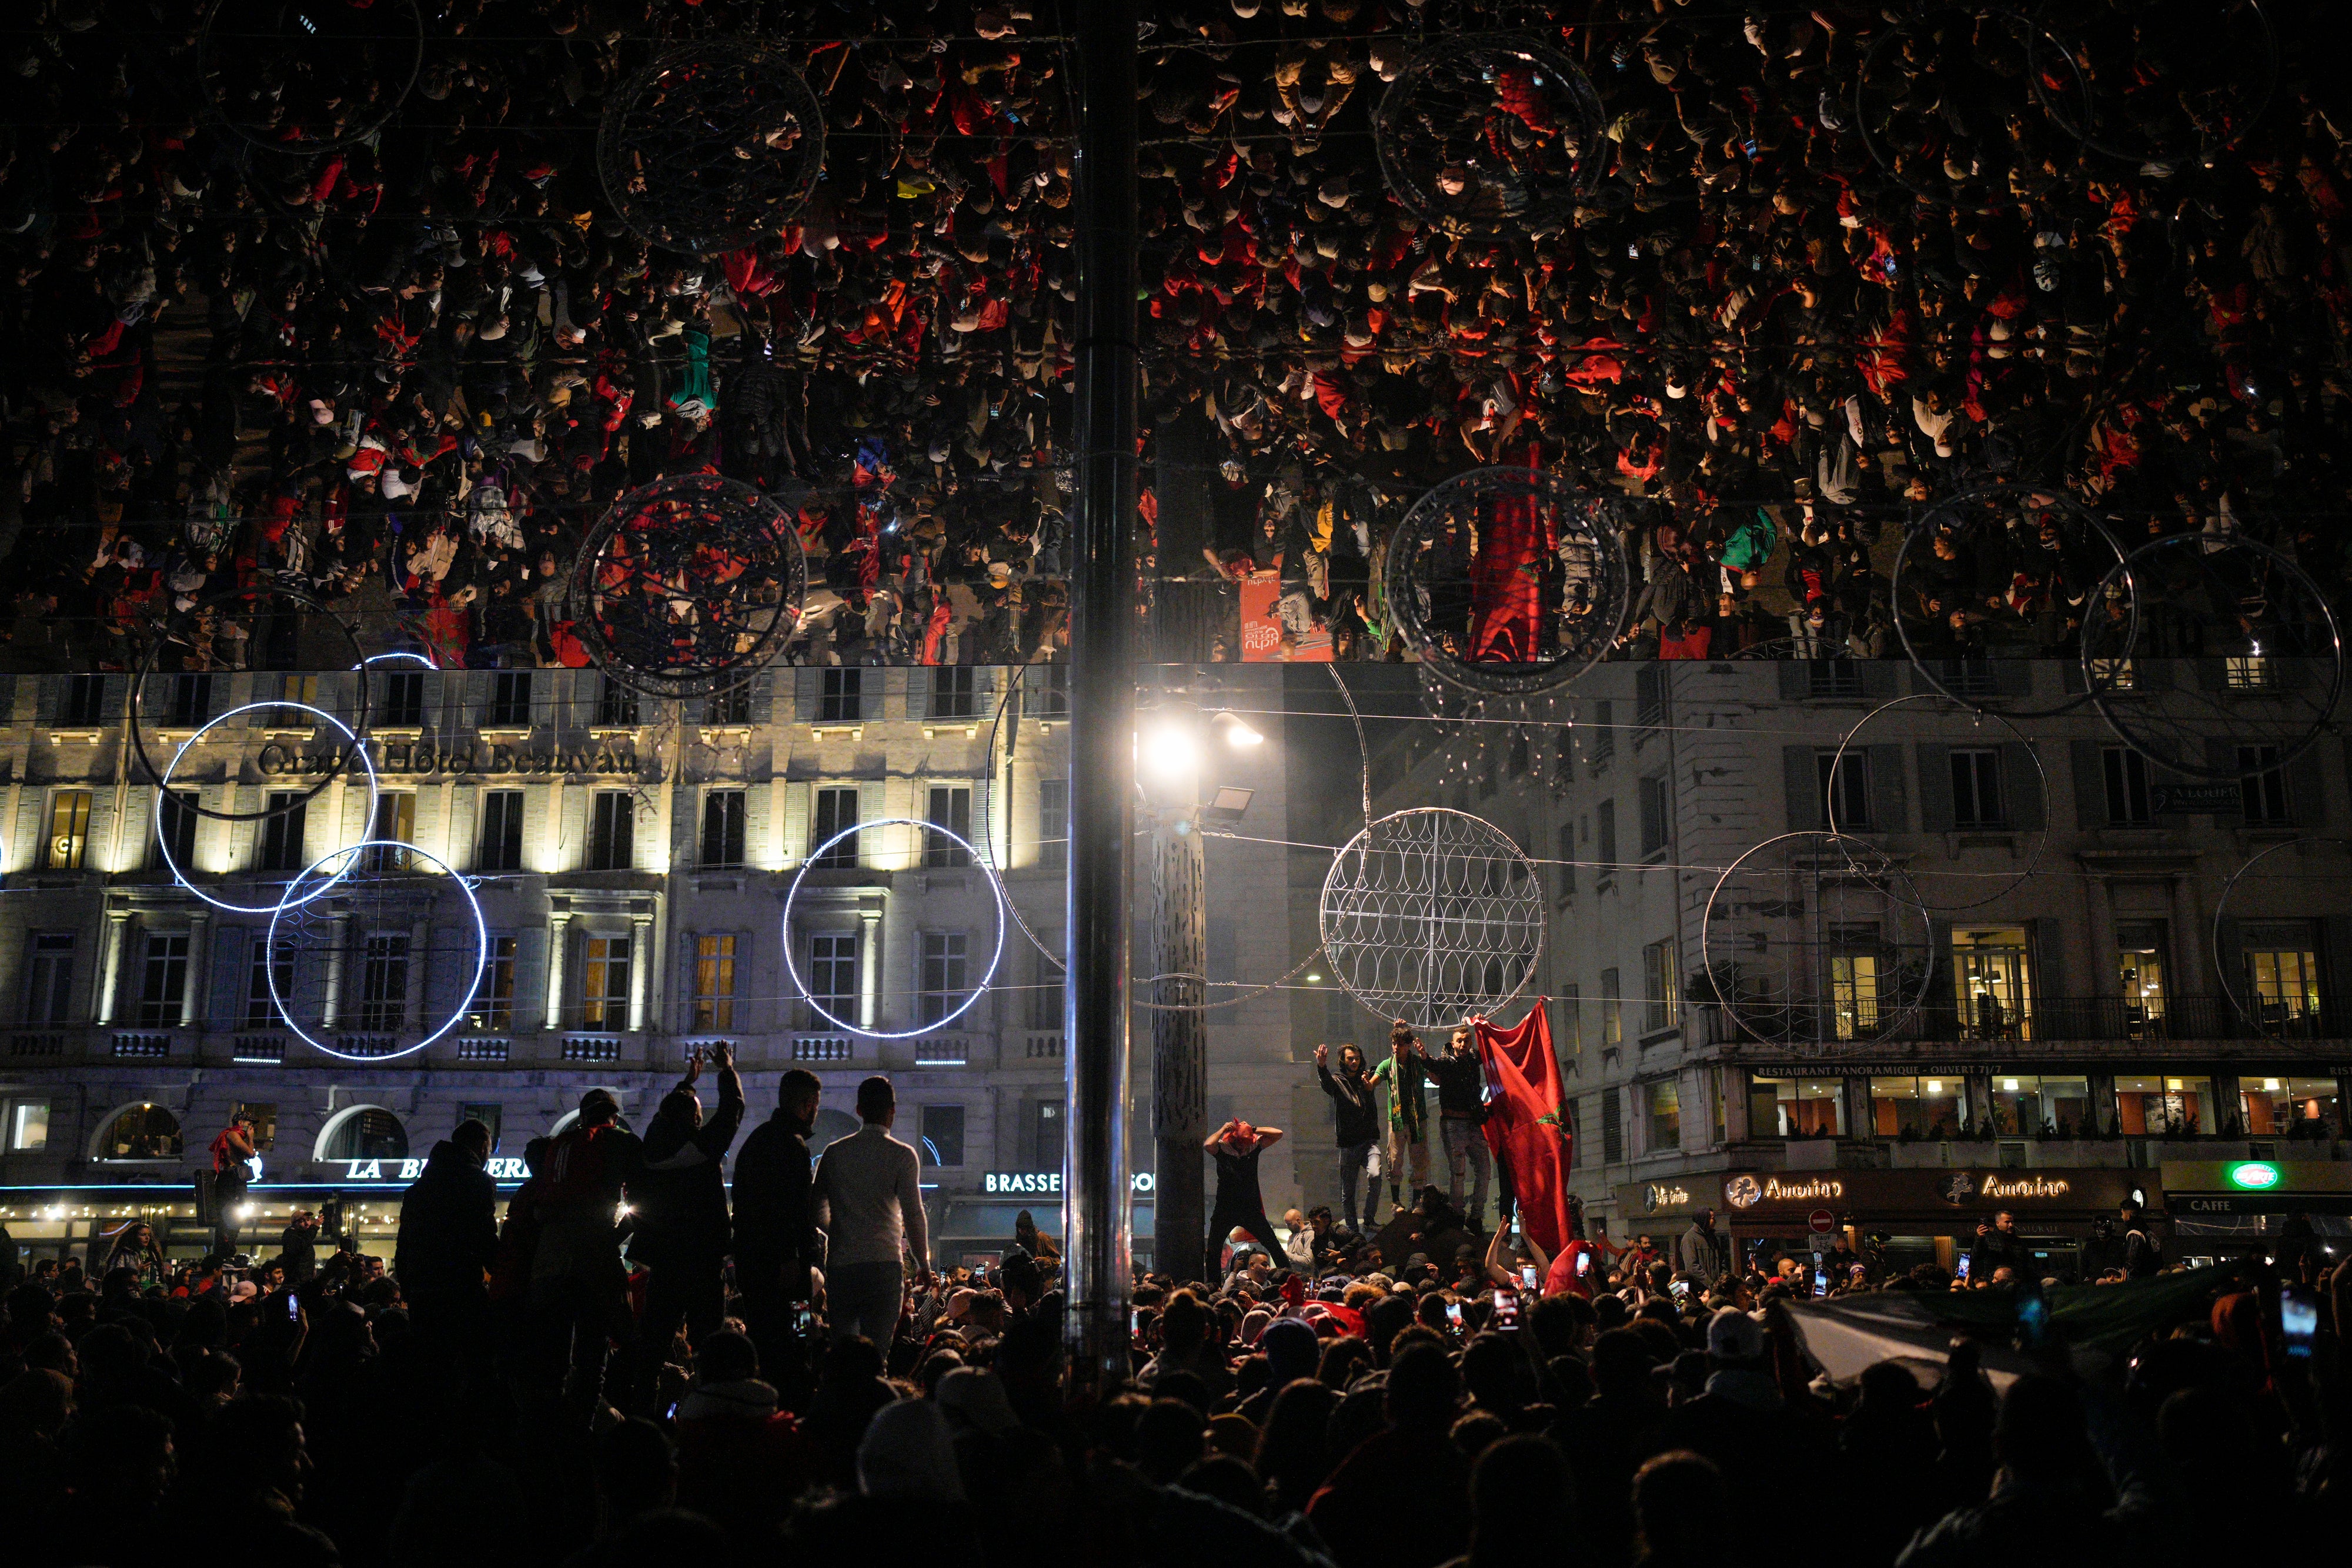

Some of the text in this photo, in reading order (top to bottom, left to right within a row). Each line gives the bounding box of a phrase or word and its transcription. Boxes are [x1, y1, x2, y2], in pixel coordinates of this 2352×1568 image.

[490, 744, 637, 775] Beauvau
[2187, 786, 2239, 797] LOUER
[1758, 1066, 1831, 1076] RESTAURANT
[1834, 1065, 1920, 1076] PANORAMIQUE
[1930, 1065, 1975, 1075] OUVERT
[346, 1158, 381, 1179] LA
[985, 1173, 1066, 1192] BRASSE
[1764, 1178, 1840, 1198] Amorino
[1983, 1176, 2067, 1196] Amorino
